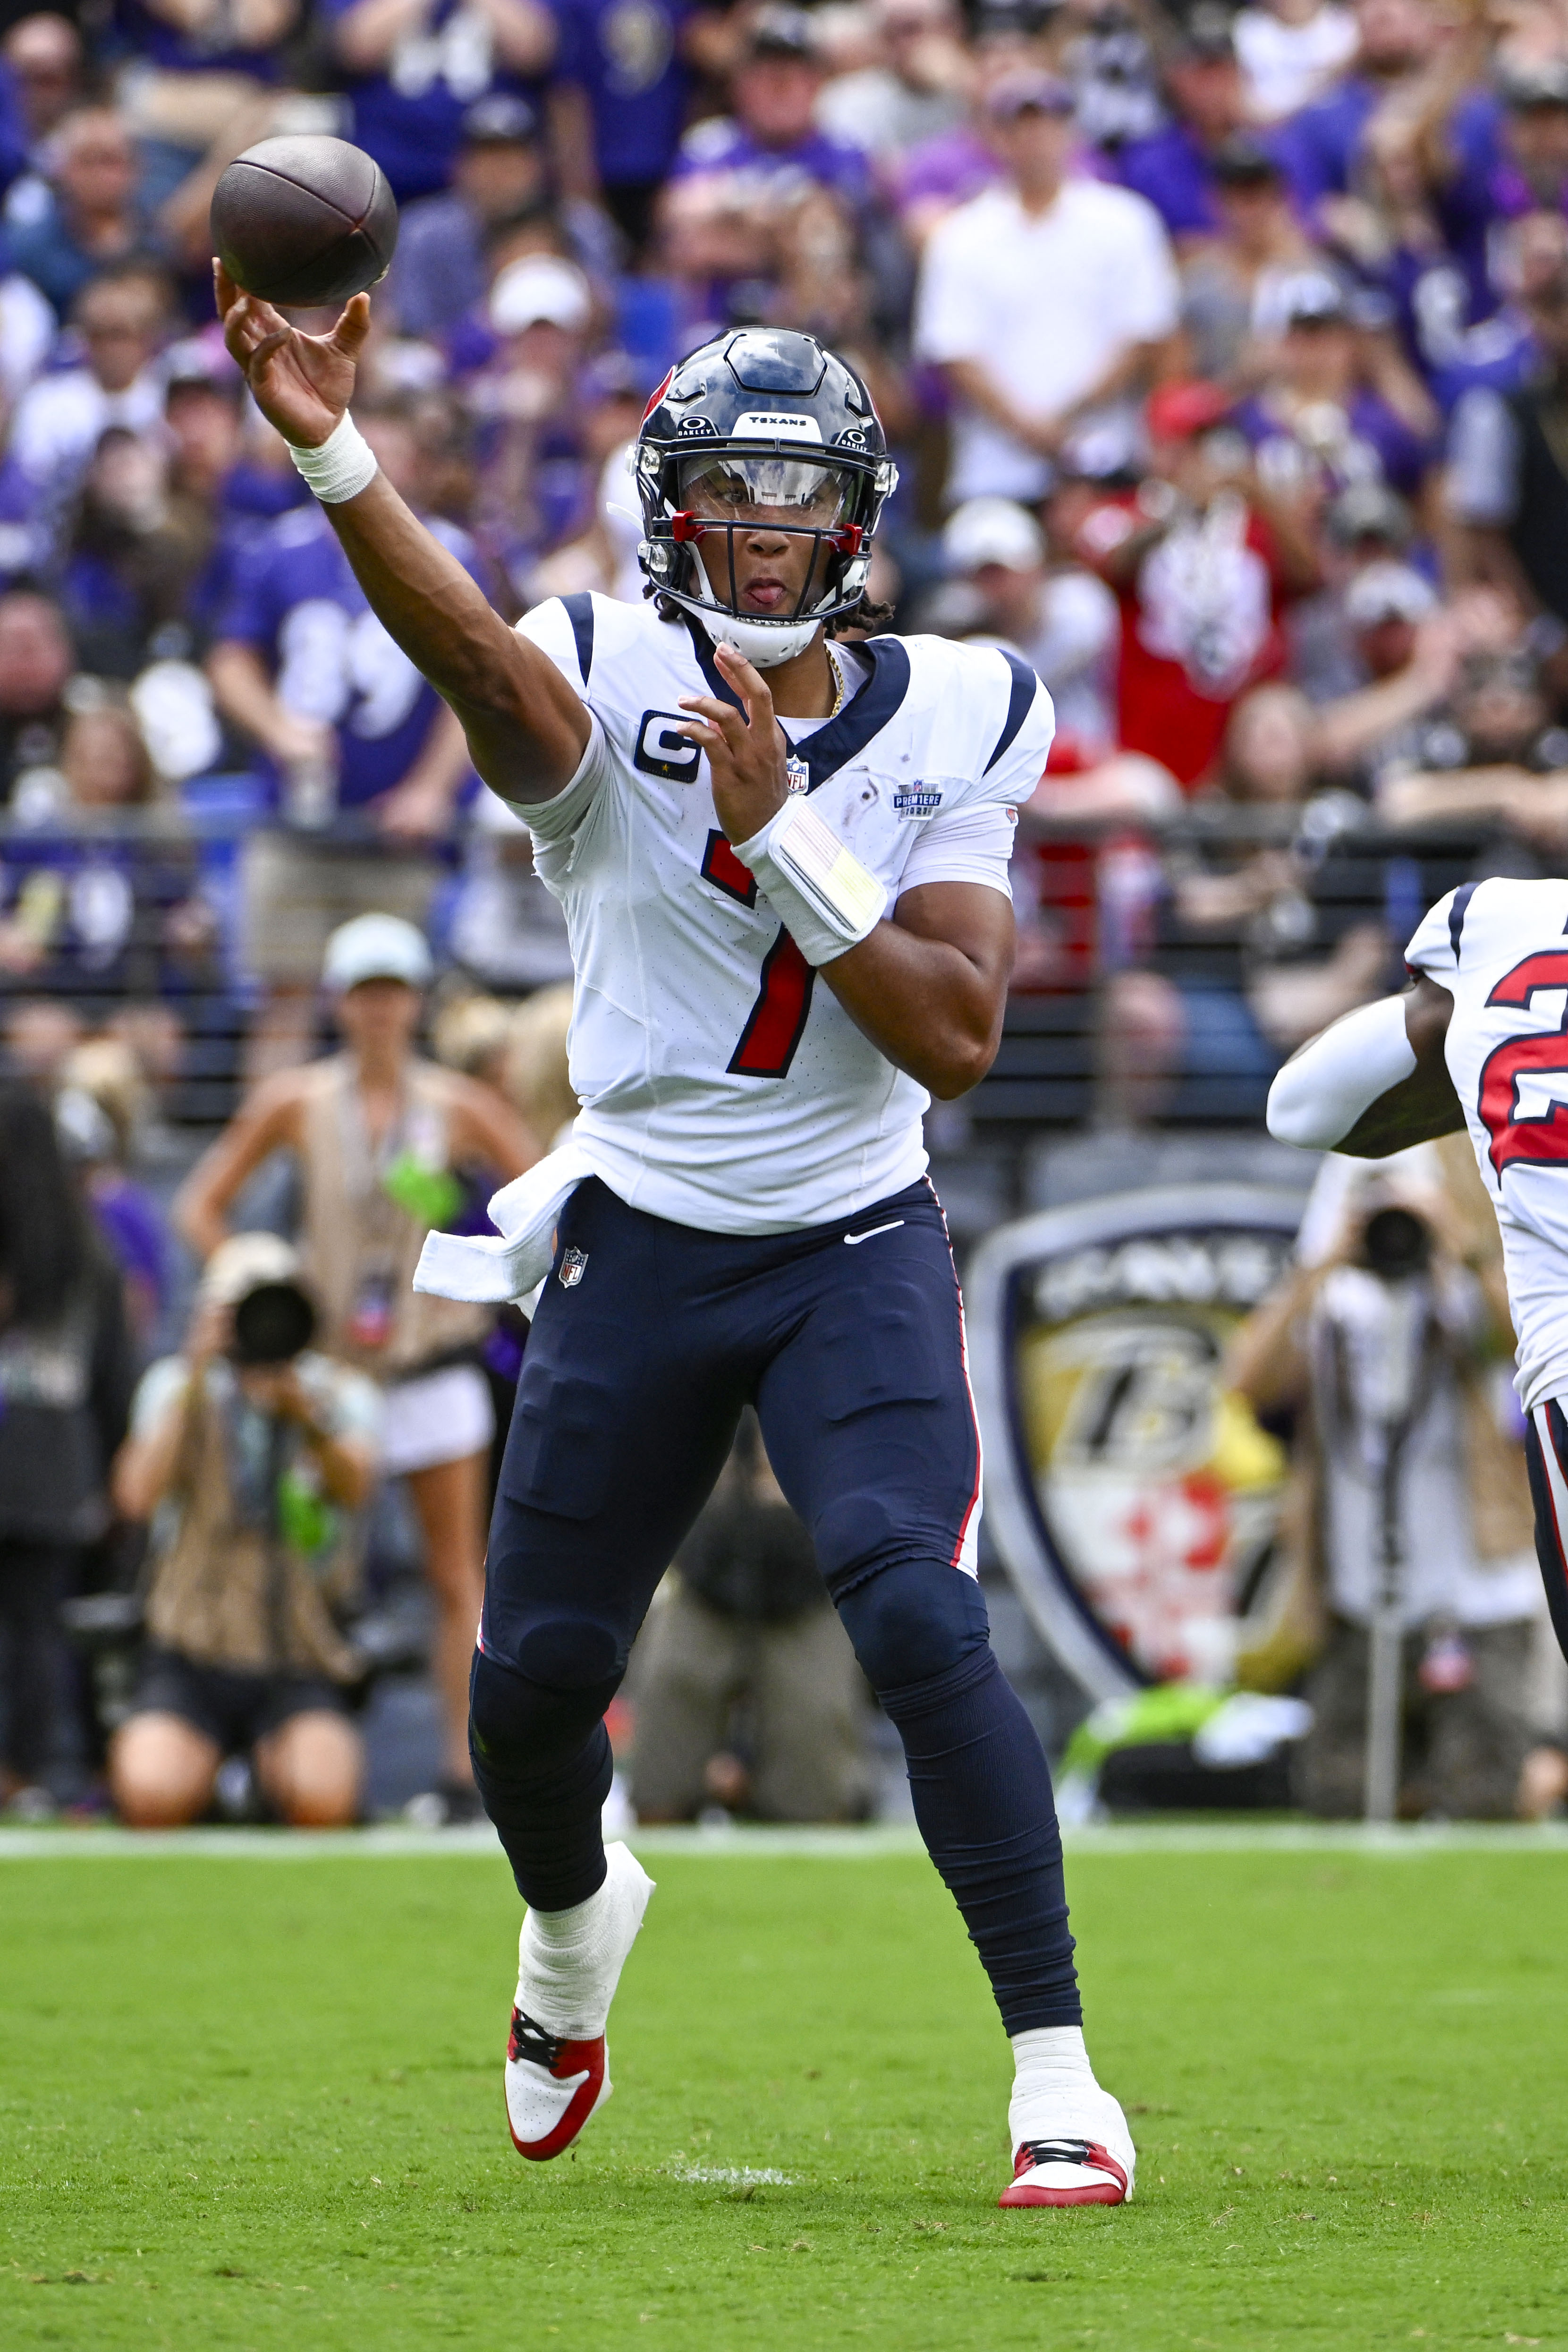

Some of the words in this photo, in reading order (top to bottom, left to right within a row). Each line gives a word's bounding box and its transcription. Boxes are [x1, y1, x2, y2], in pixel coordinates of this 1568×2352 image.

[749, 417, 806, 426] TEXANS
[642, 716, 697, 765] C
[562, 1264, 578, 1281] NFL
